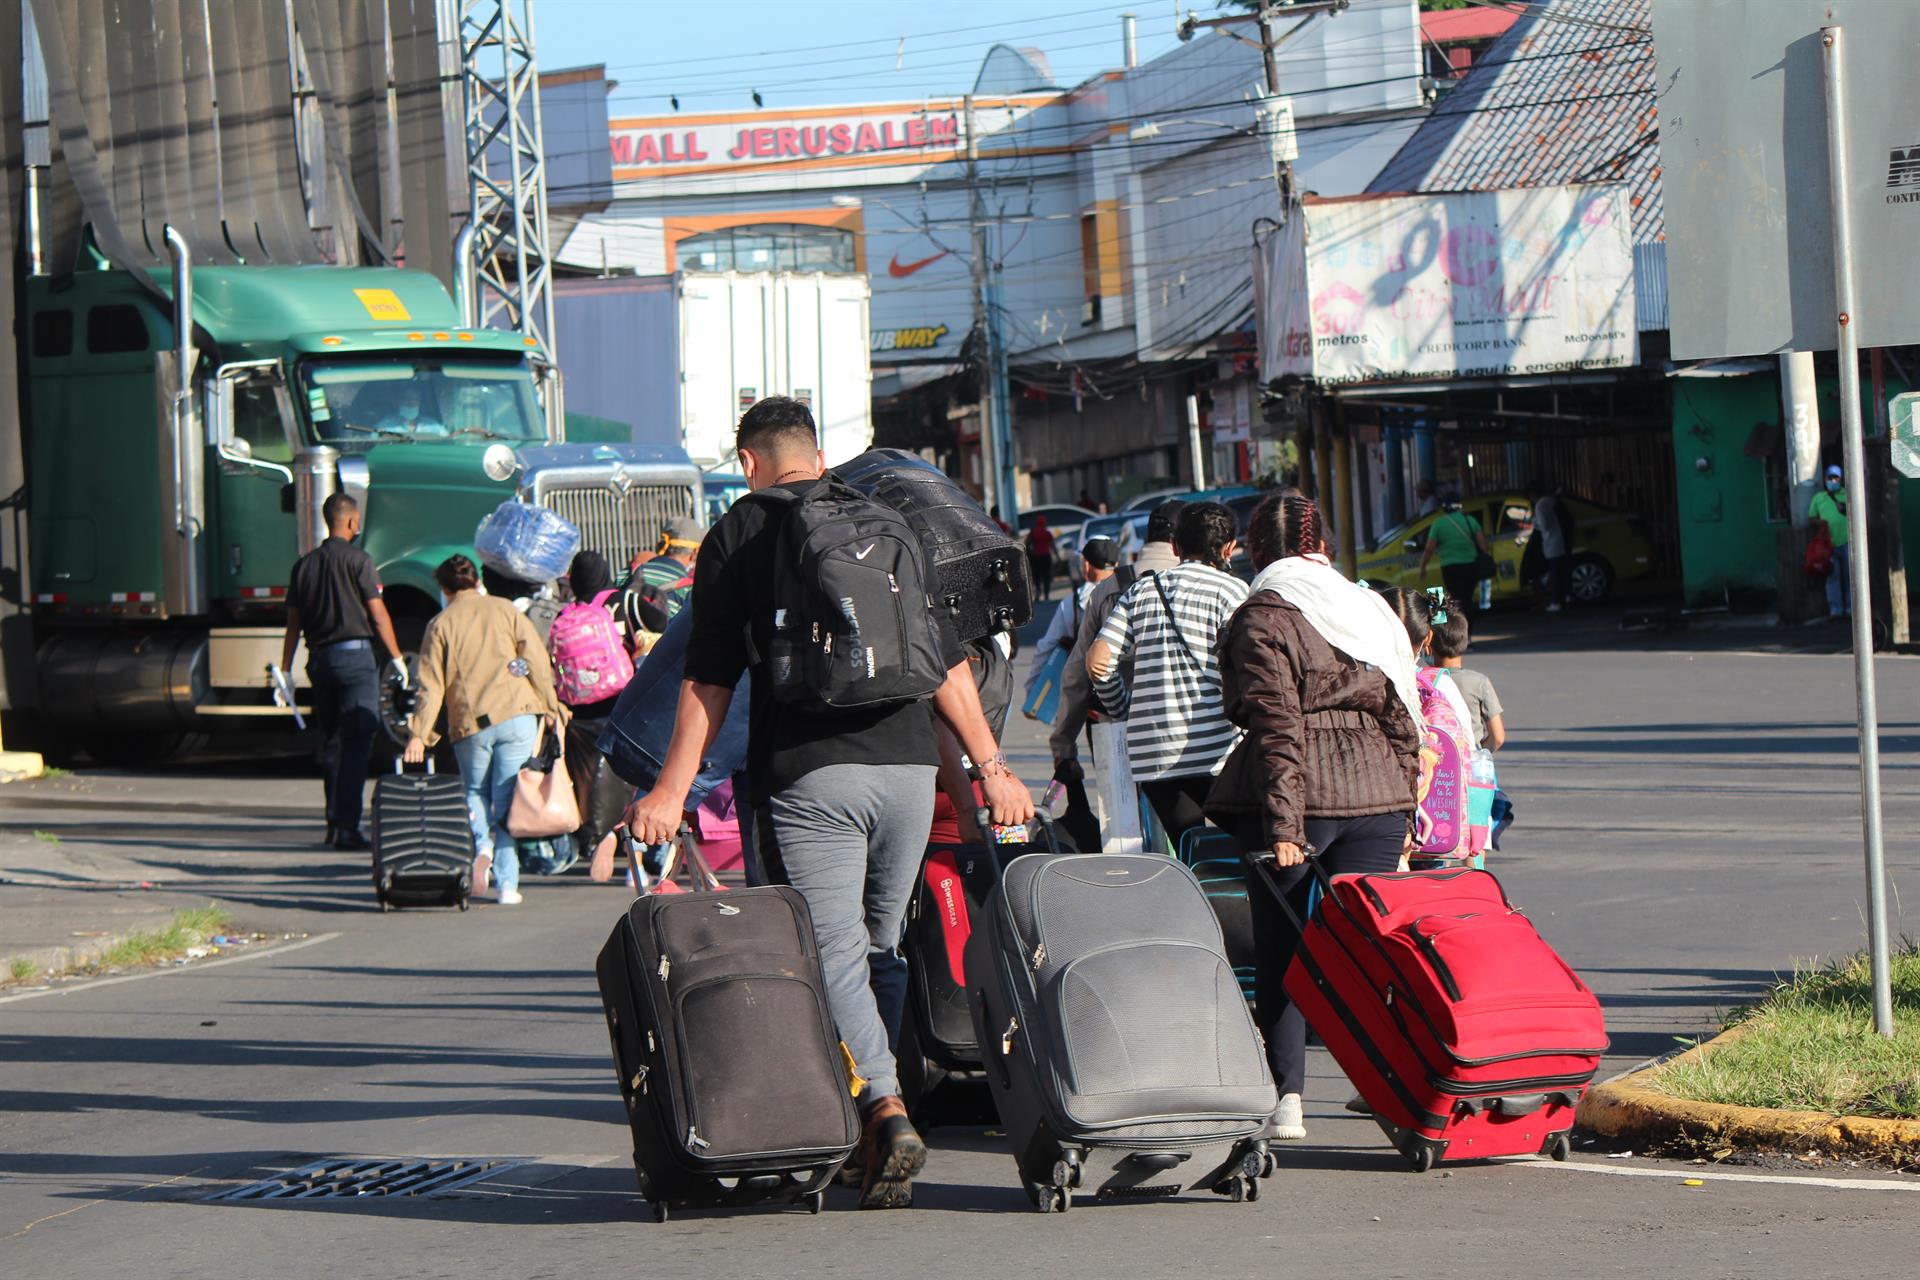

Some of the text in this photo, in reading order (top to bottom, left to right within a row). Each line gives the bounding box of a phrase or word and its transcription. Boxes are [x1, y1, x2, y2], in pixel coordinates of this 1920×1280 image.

[610, 118, 958, 164] MALL JERUSALEM
[870, 324, 948, 351] UBWAY
[1317, 333, 1368, 347] metros
[1418, 337, 1526, 353] CREDICORP BANK
[1564, 331, 1626, 344] McDonald's
[1426, 797, 1458, 810] AWESOME
